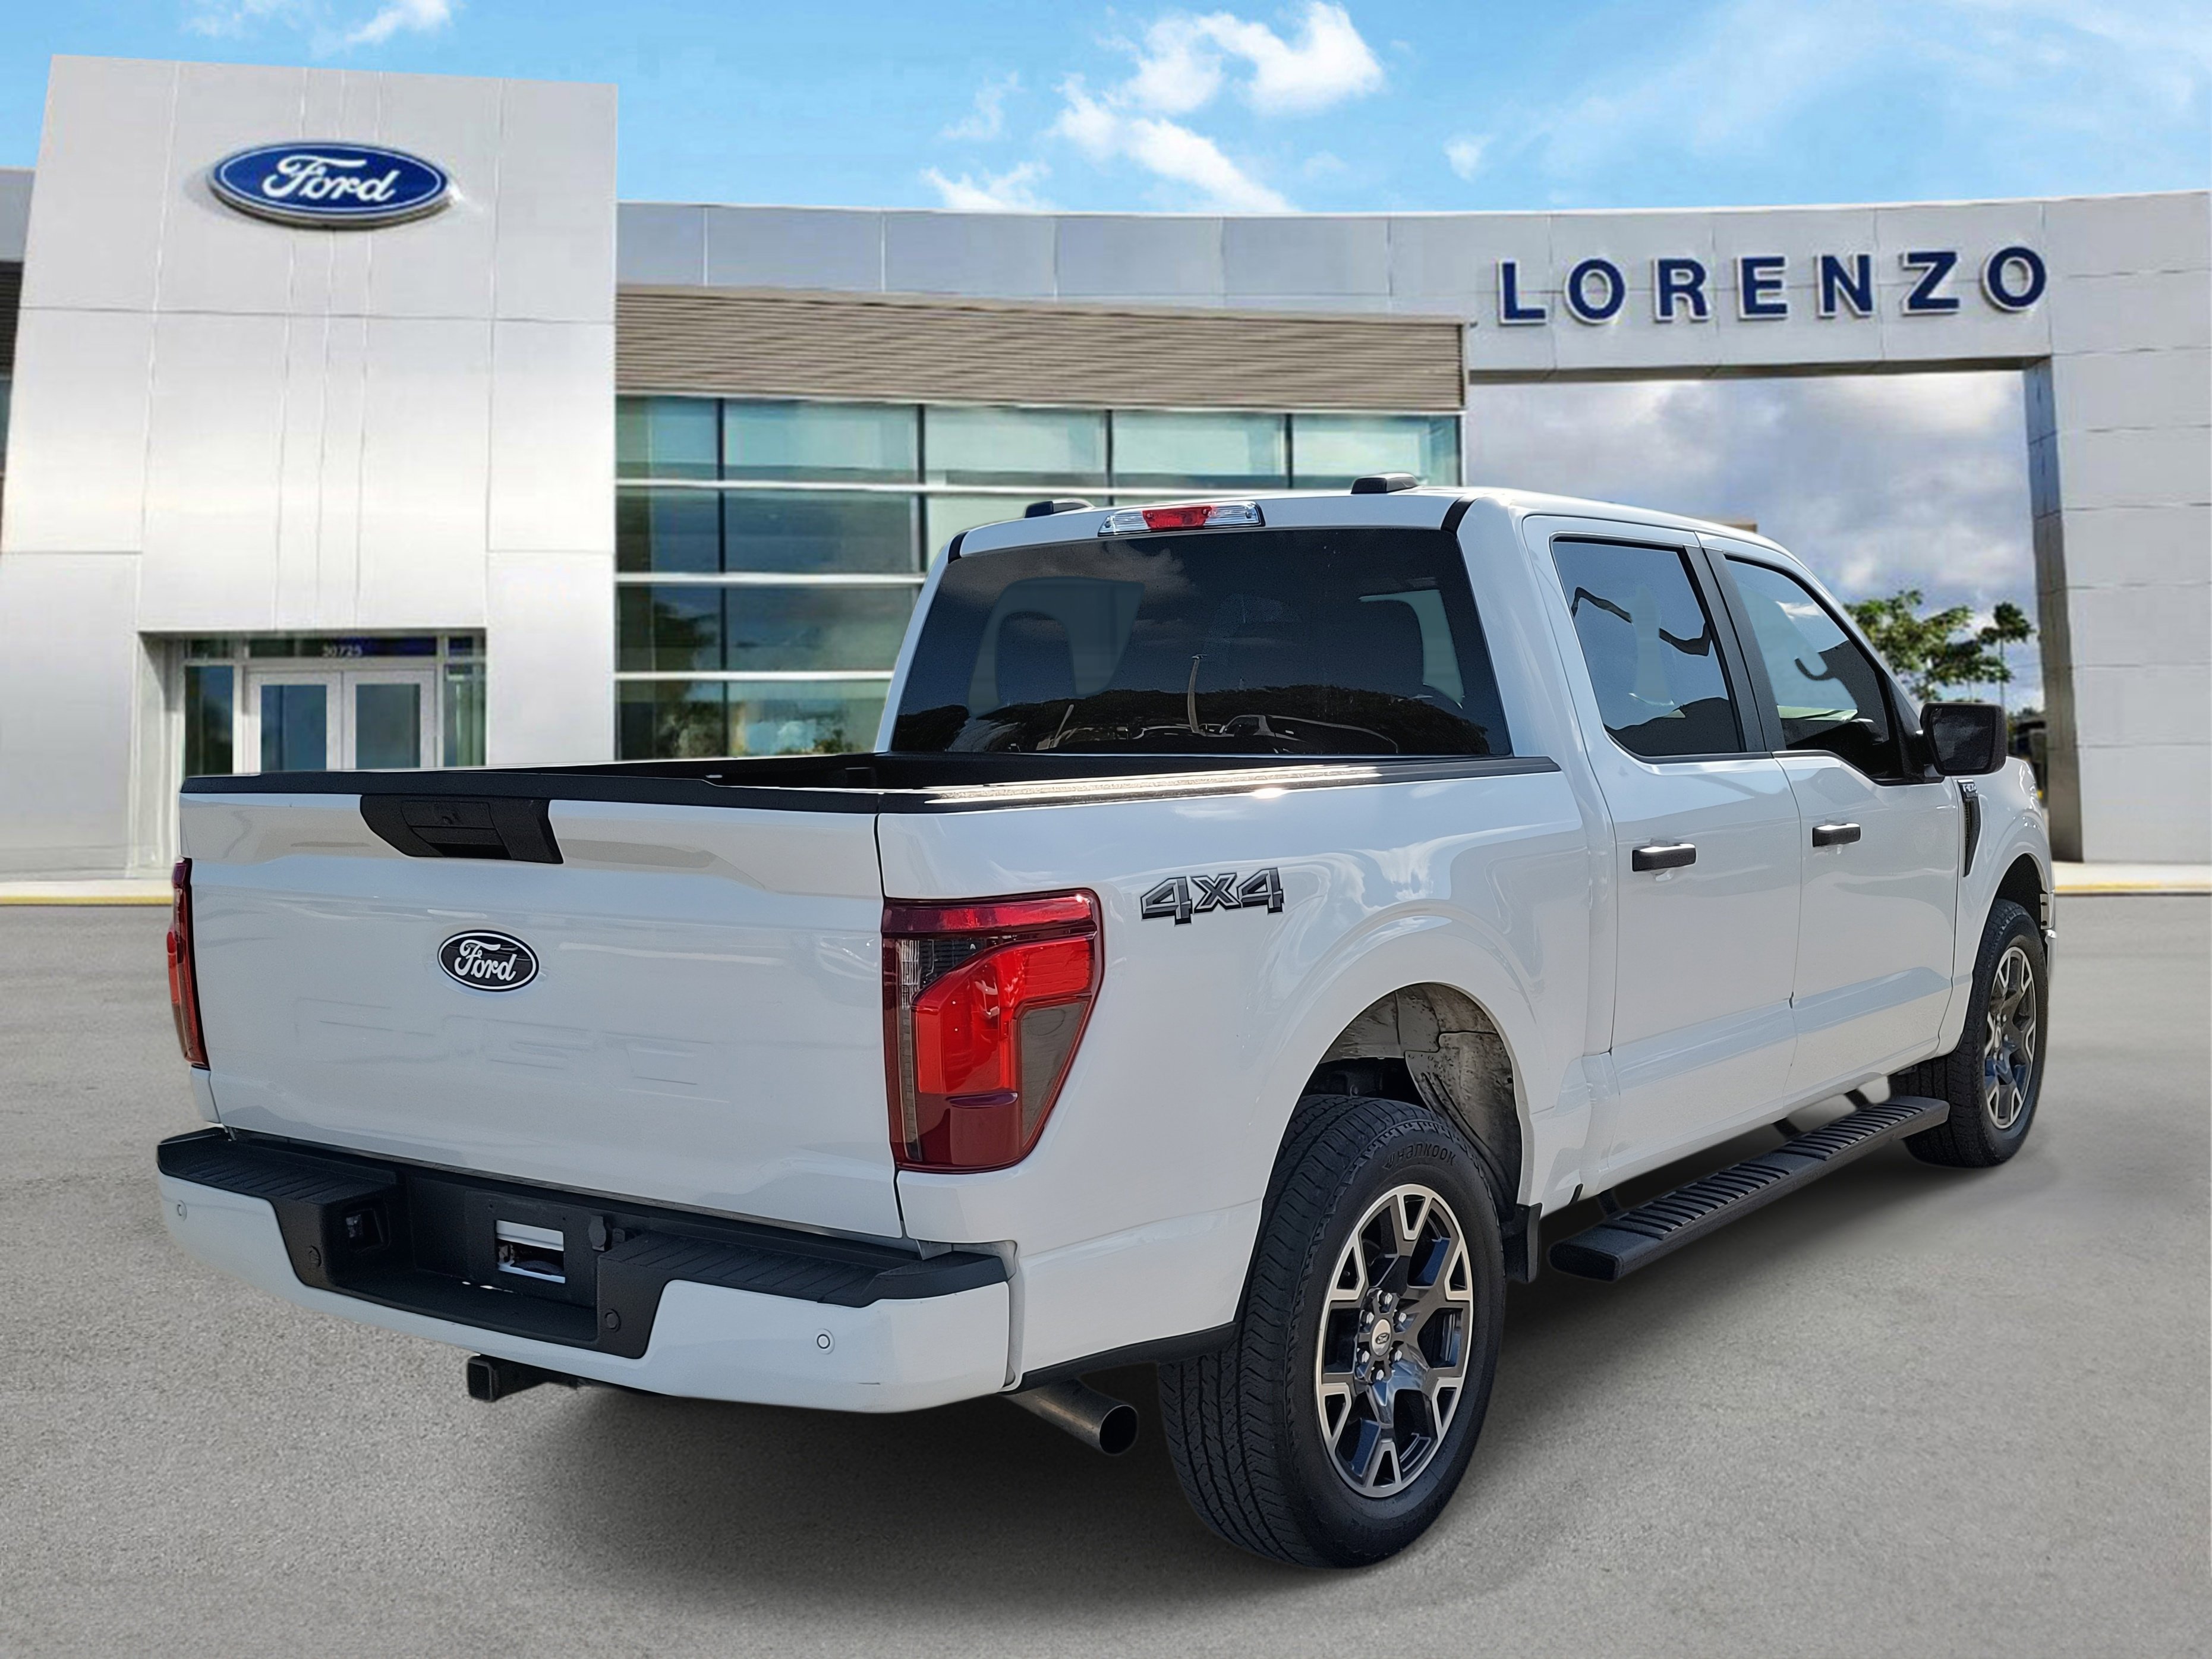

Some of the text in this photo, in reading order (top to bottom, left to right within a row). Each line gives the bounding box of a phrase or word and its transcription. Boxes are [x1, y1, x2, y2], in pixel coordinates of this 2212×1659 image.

[262, 155, 401, 202] Ford
[1498, 246, 2047, 326] LORENZO
[454, 939, 518, 981] Ford
